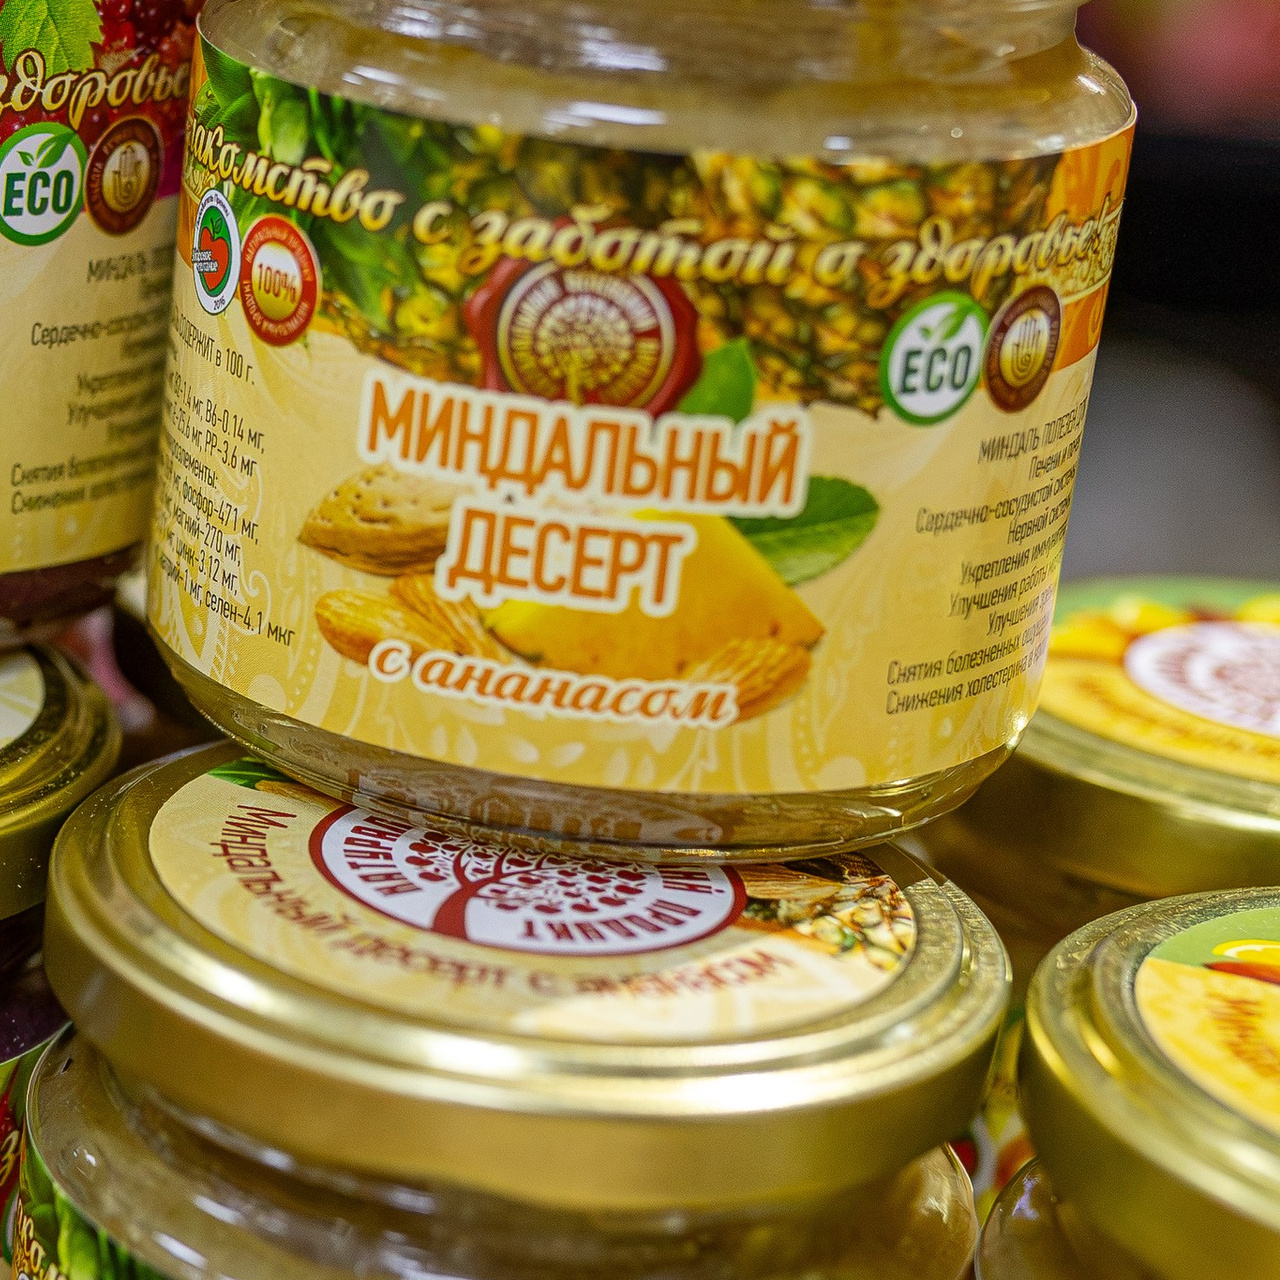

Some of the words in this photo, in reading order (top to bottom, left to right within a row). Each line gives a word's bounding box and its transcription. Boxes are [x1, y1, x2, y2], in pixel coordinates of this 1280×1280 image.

[3, 167, 76, 218] ECO
[413, 199, 454, 245] с
[458, 203, 797, 285] заботой
[225, 347, 244, 379] 100
[899, 345, 971, 395] ECO
[240, 455, 257, 477] мг
[366, 380, 802, 507] МИНДАЛЬНЫЙ
[977, 427, 1040, 465] МИНДАЛЬ
[446, 508, 684, 607] ДЕСЕРТ
[960, 547, 1030, 588] Укрепления
[205, 589, 264, 636] селен-4.1
[267, 621, 296, 647] мкг
[948, 581, 1017, 620] Улучшения
[376, 644, 410, 676] с
[420, 657, 734, 722] ананасом
[886, 658, 942, 687] Снятия
[885, 682, 963, 716] Снижения
